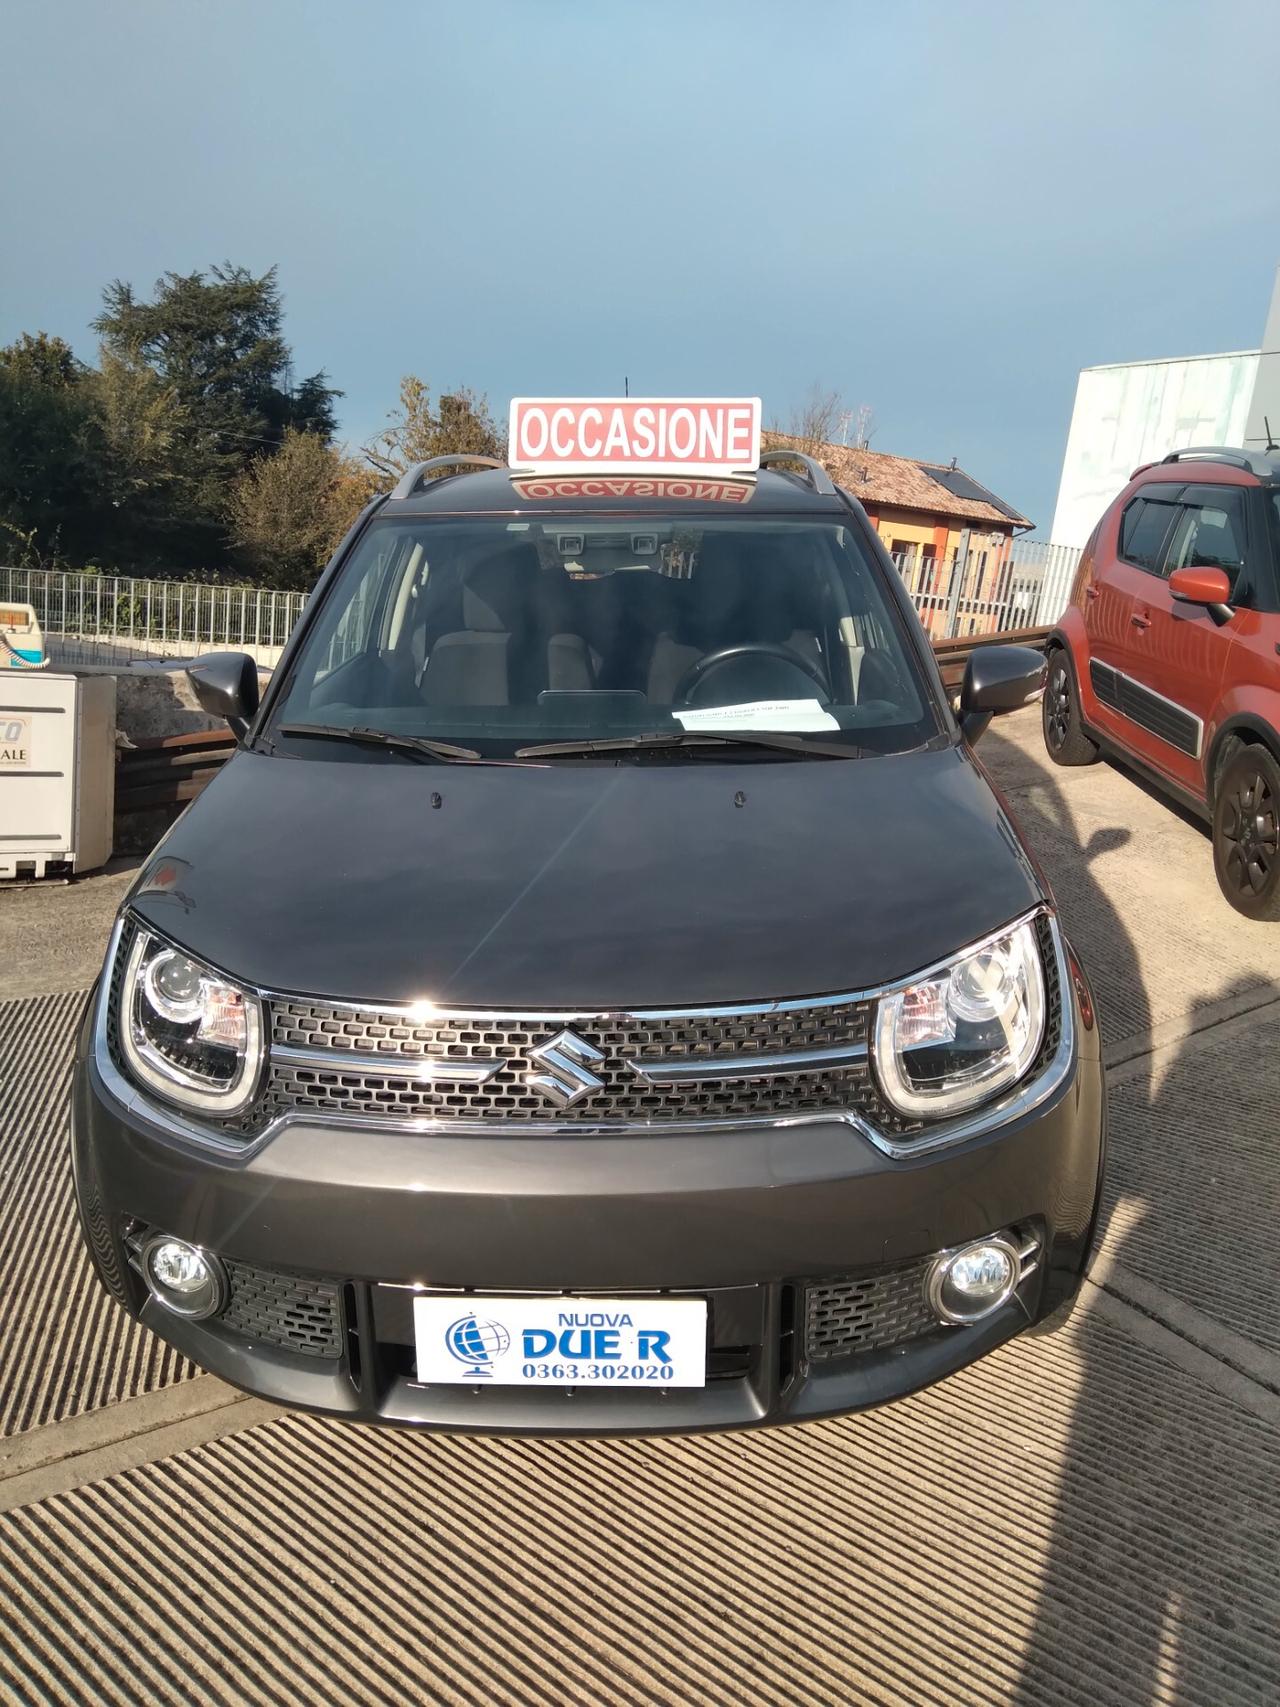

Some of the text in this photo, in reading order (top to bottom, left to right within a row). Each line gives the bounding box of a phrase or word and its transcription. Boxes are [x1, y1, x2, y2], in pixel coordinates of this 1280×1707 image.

[520, 407, 751, 459] OCCASIONE
[558, 1313, 633, 1328] NUOVA
[521, 1363, 674, 1380] 0363.302020
